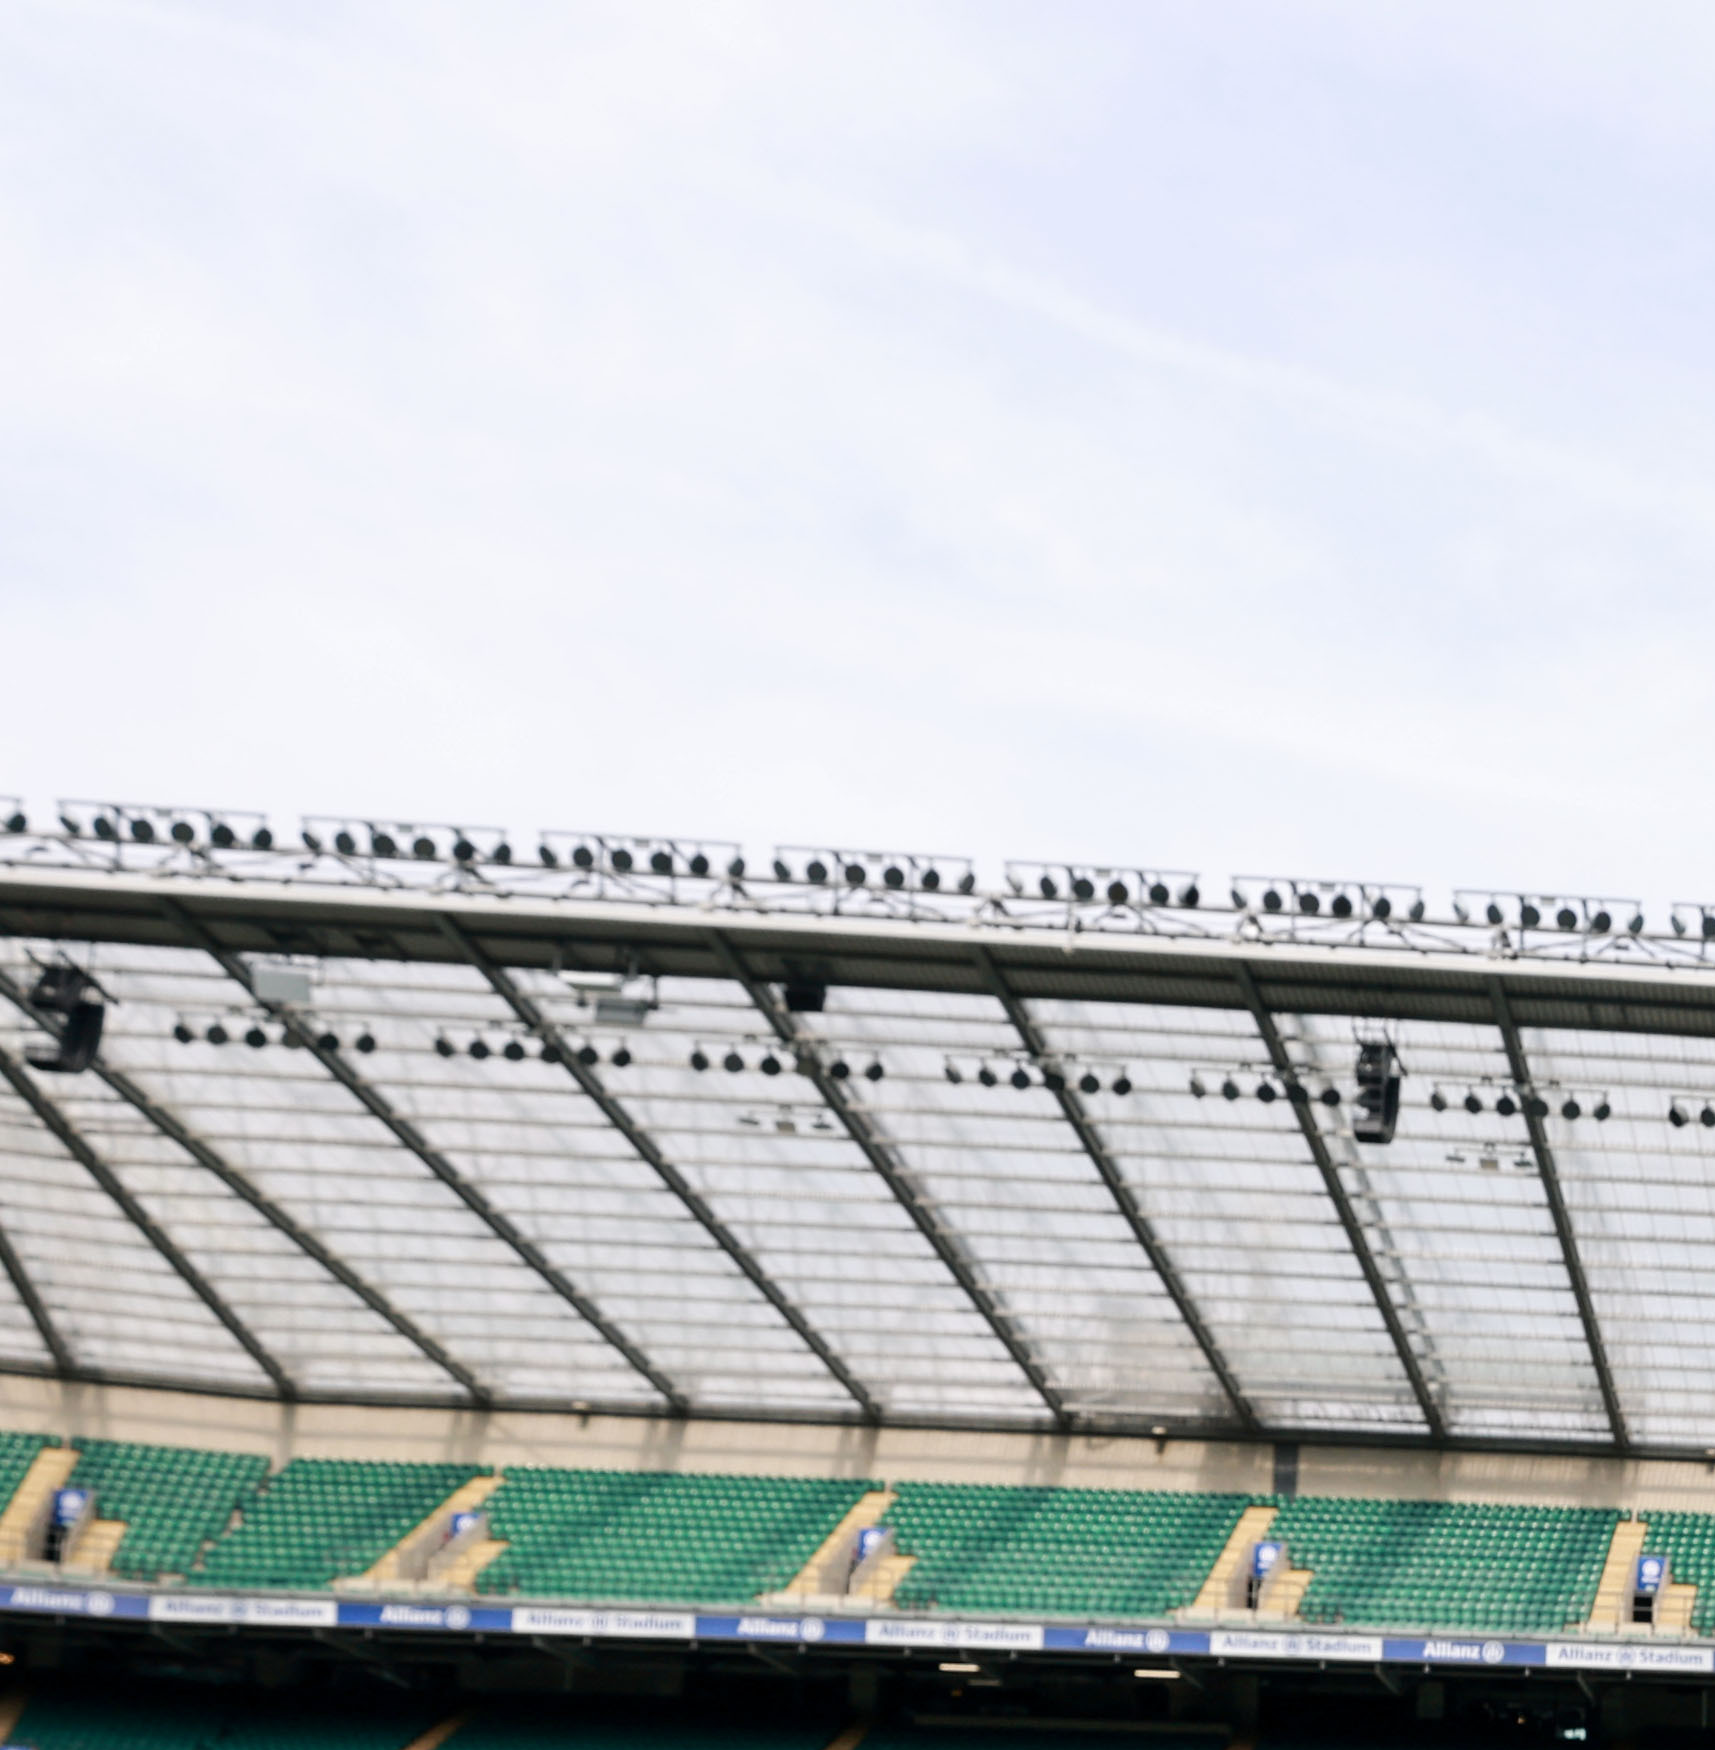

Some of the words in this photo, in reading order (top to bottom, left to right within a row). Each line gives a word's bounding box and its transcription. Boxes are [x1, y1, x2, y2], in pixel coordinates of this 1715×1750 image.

[381, 1606, 443, 1625] Allianz
[738, 1618, 799, 1635] Allianz
[1086, 1630, 1144, 1647] Allianz
[1424, 1642, 1480, 1659] Allianz
